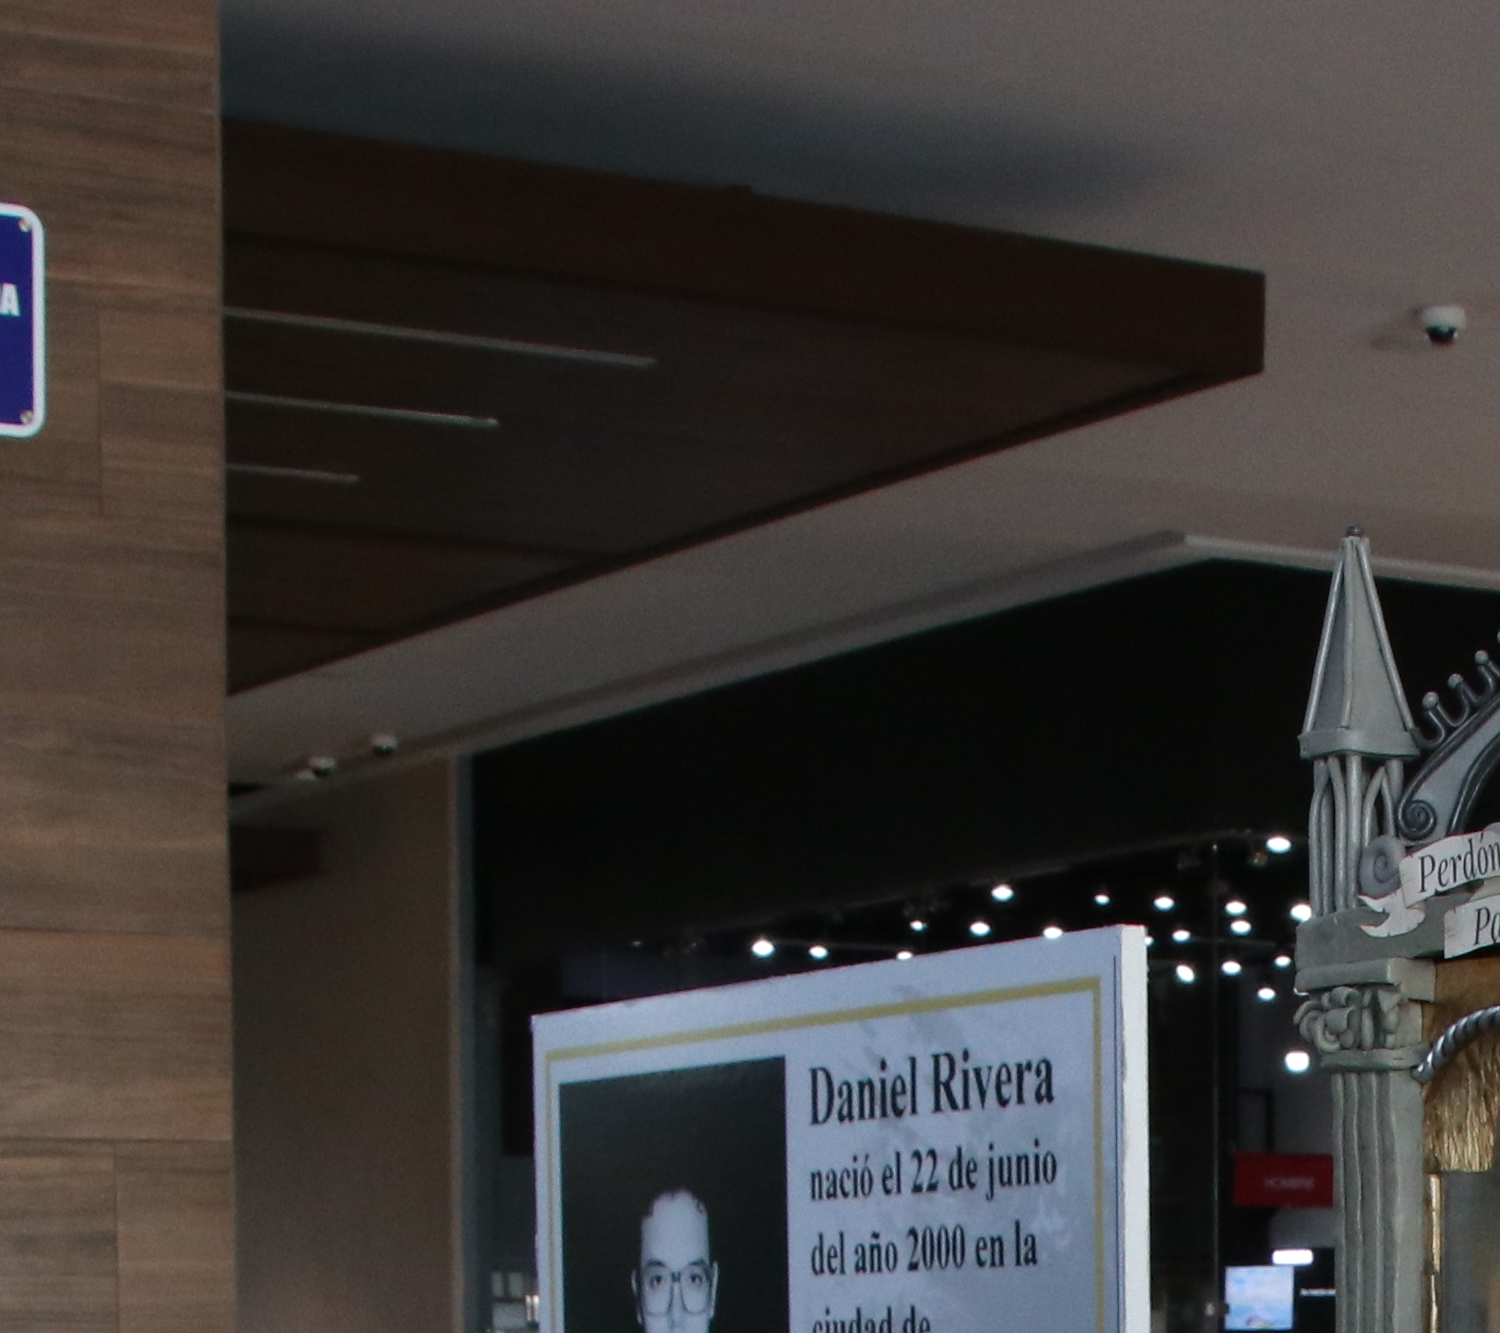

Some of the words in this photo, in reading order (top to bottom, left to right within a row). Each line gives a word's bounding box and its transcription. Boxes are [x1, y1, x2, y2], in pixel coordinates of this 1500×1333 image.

[809, 1057, 918, 1126] Daniel
[932, 1049, 1055, 1112] Rivera
[810, 1150, 874, 1201] nació
[882, 1153, 901, 1195] el
[911, 1148, 940, 1195] 22
[948, 1149, 979, 1191] de
[985, 1139, 1058, 1200] junio
[811, 1231, 846, 1276] del
[854, 1231, 899, 1274] año
[907, 1223, 967, 1271] 2000
[975, 1235, 1005, 1268] en
[1014, 1222, 1038, 1266] la
